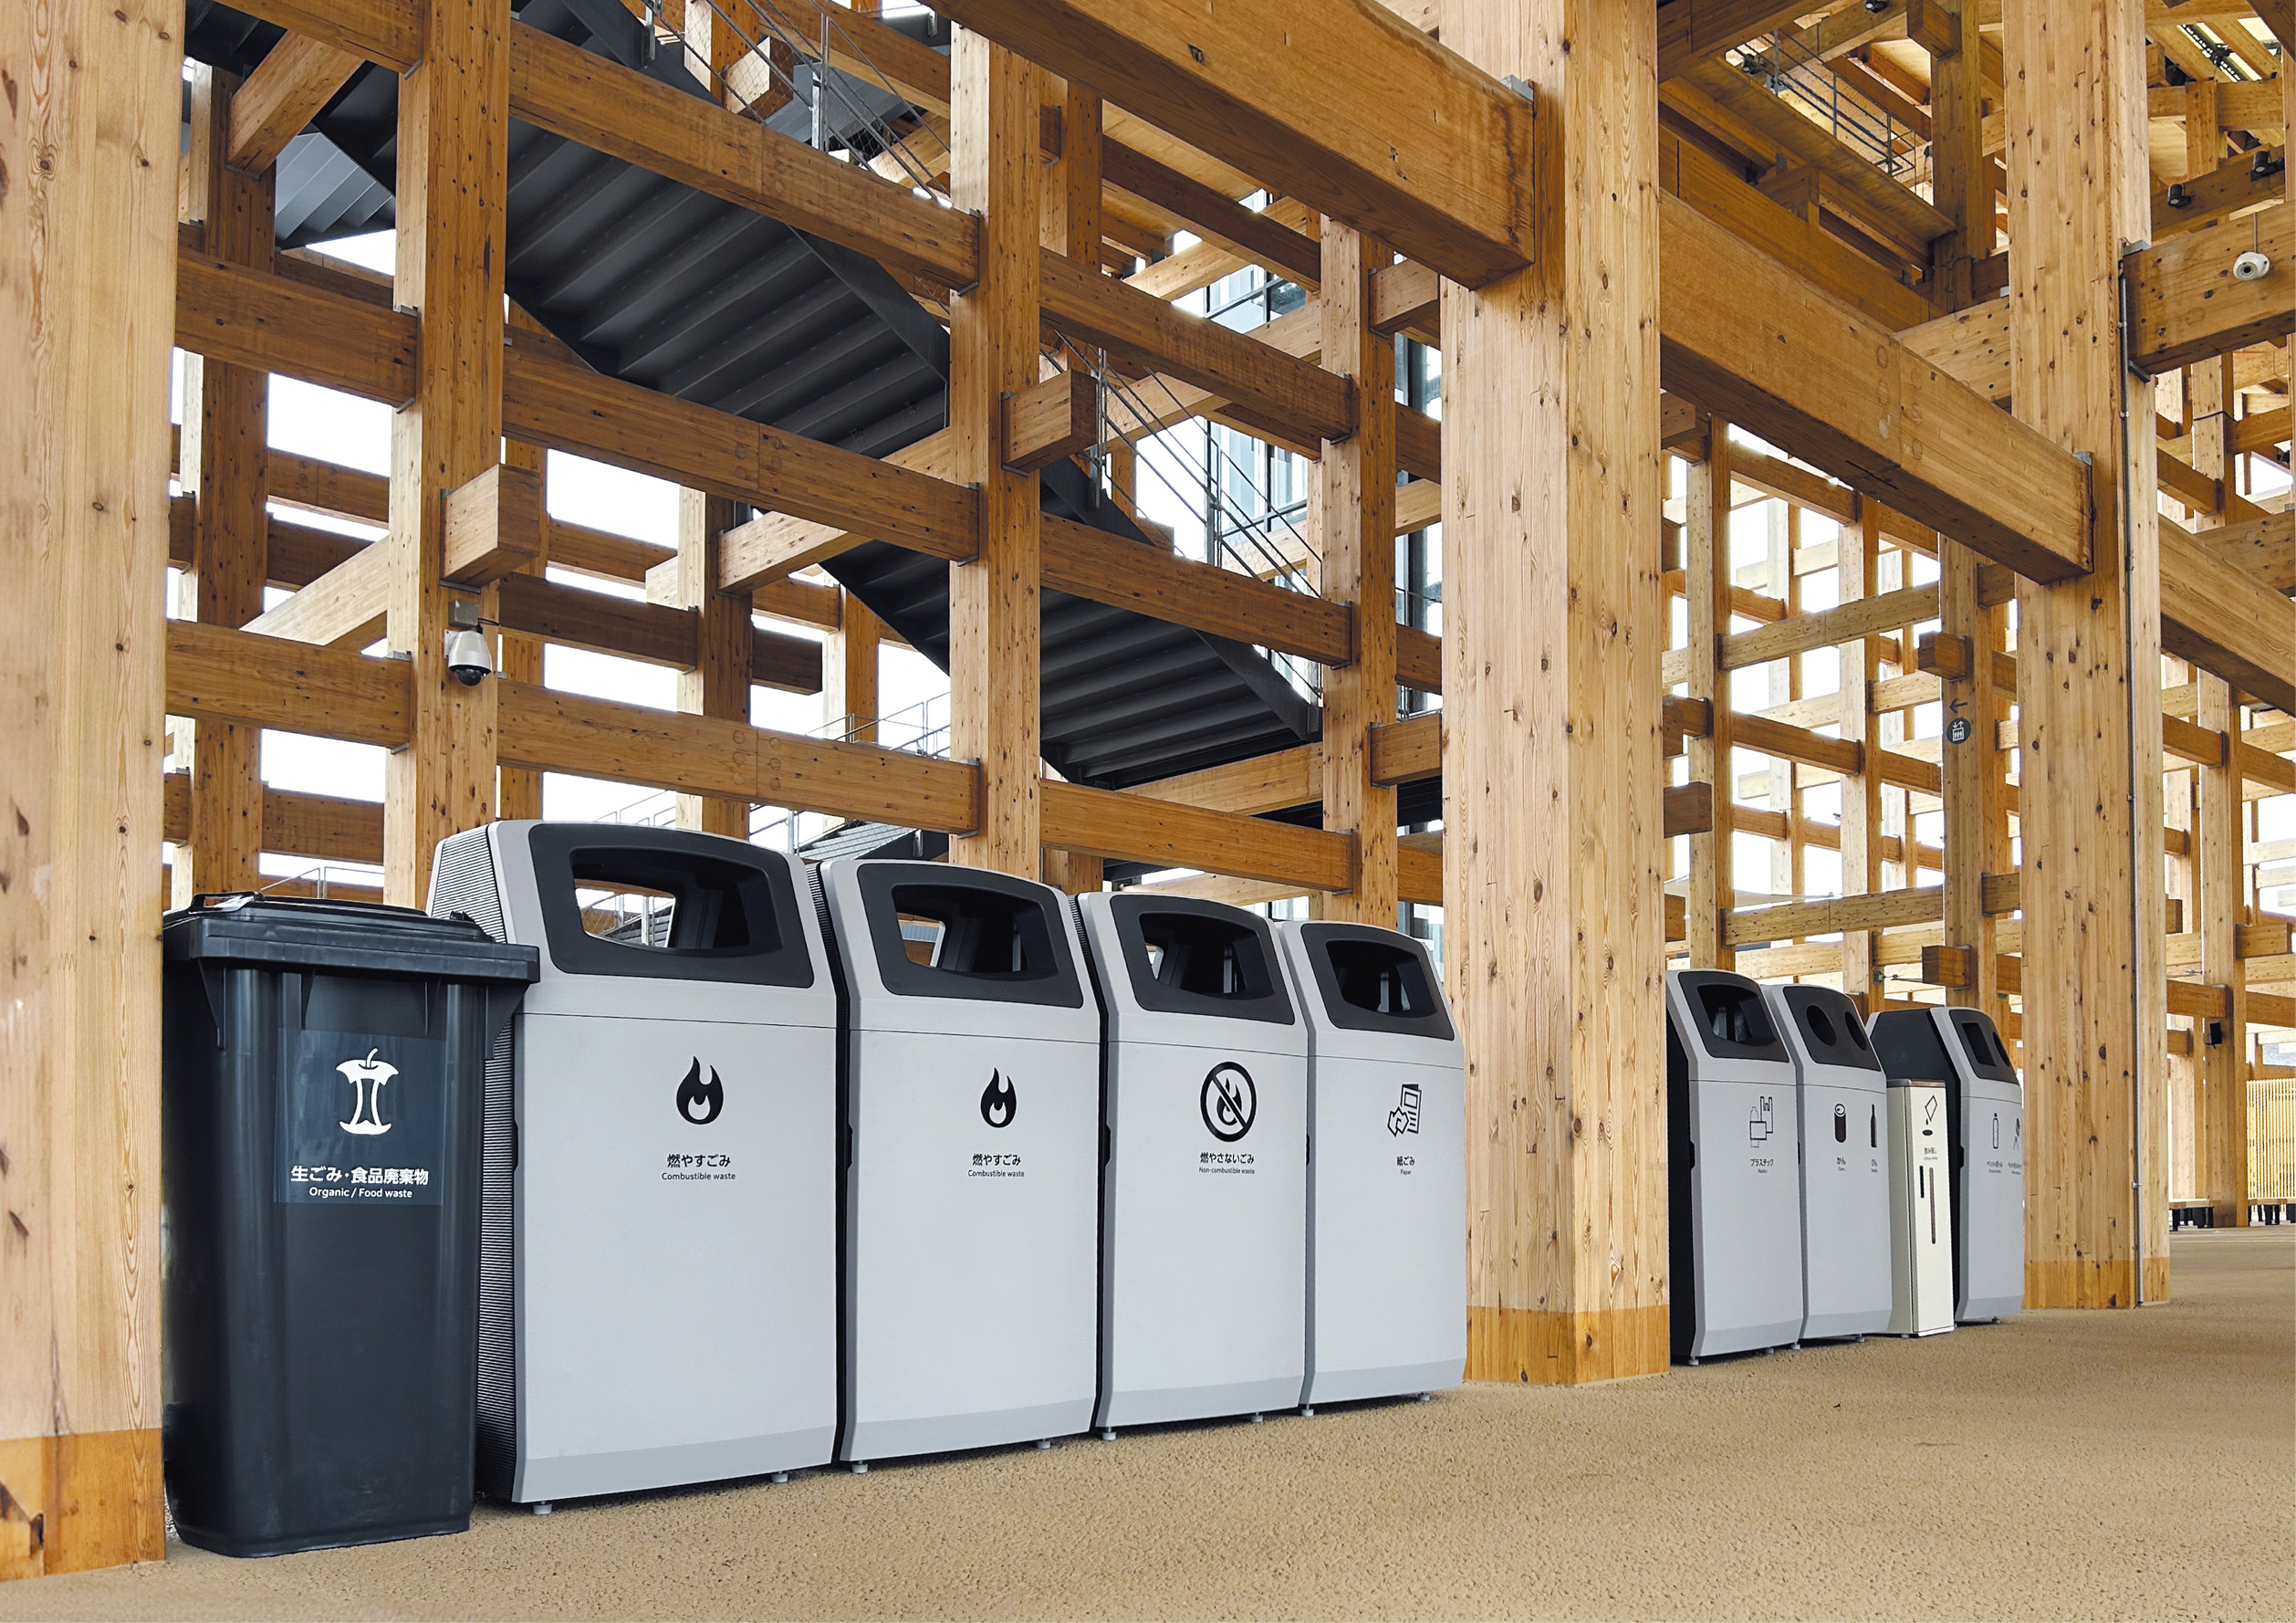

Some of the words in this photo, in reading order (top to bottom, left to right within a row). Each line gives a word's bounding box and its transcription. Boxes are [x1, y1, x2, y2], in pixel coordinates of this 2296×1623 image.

[667, 1154, 731, 1168] 燃やすごみ
[972, 1153, 1021, 1166] 燃やすごみ
[1200, 1152, 1255, 1164] 燃やさないごみ
[290, 1165, 429, 1186] 生ごみ・食品廃棄物
[662, 1172, 712, 1180] Combustible
[967, 1169, 1007, 1178] Combustible
[1198, 1167, 1241, 1175] Non-combustible
[308, 1187, 350, 1199] Organic
[350, 1188, 357, 1199] /
[359, 1188, 383, 1198] Food
[384, 1189, 413, 1199] waste
